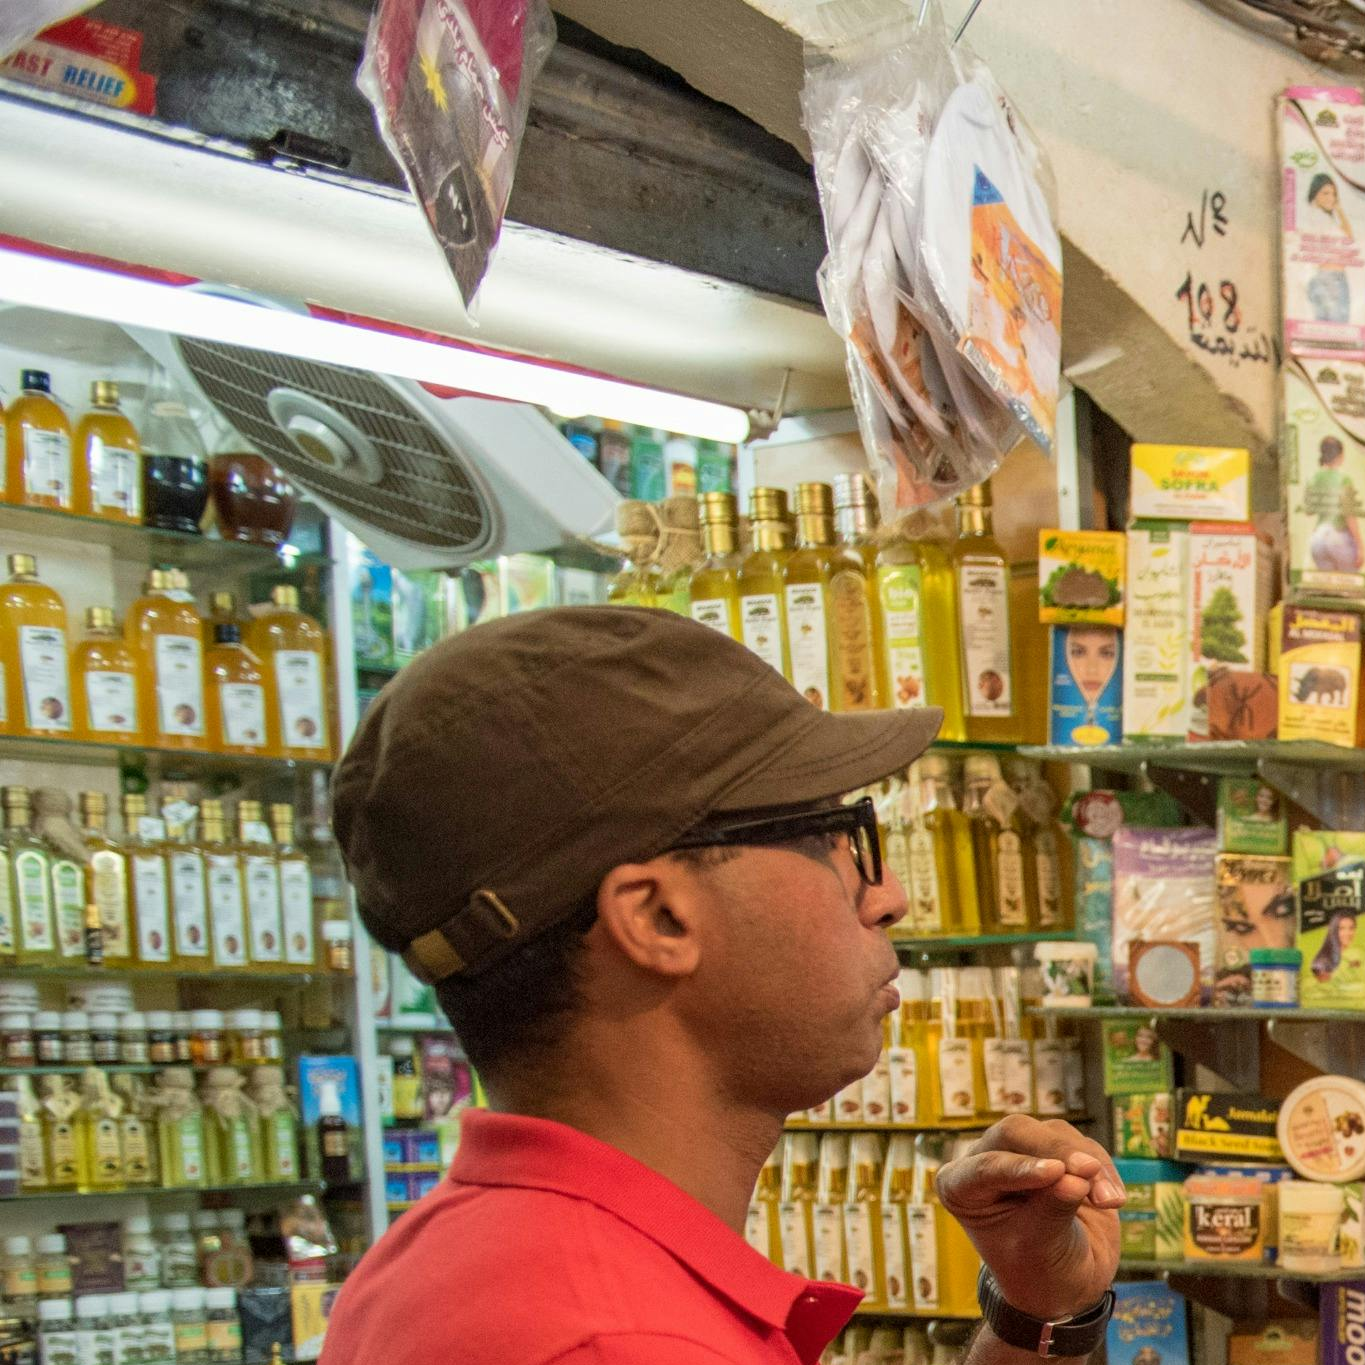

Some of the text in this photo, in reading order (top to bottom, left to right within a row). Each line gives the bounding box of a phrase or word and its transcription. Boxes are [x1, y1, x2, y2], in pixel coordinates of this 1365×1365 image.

[4, 50, 125, 97] AST RELIEF
[1177, 271, 1241, 334] 108
